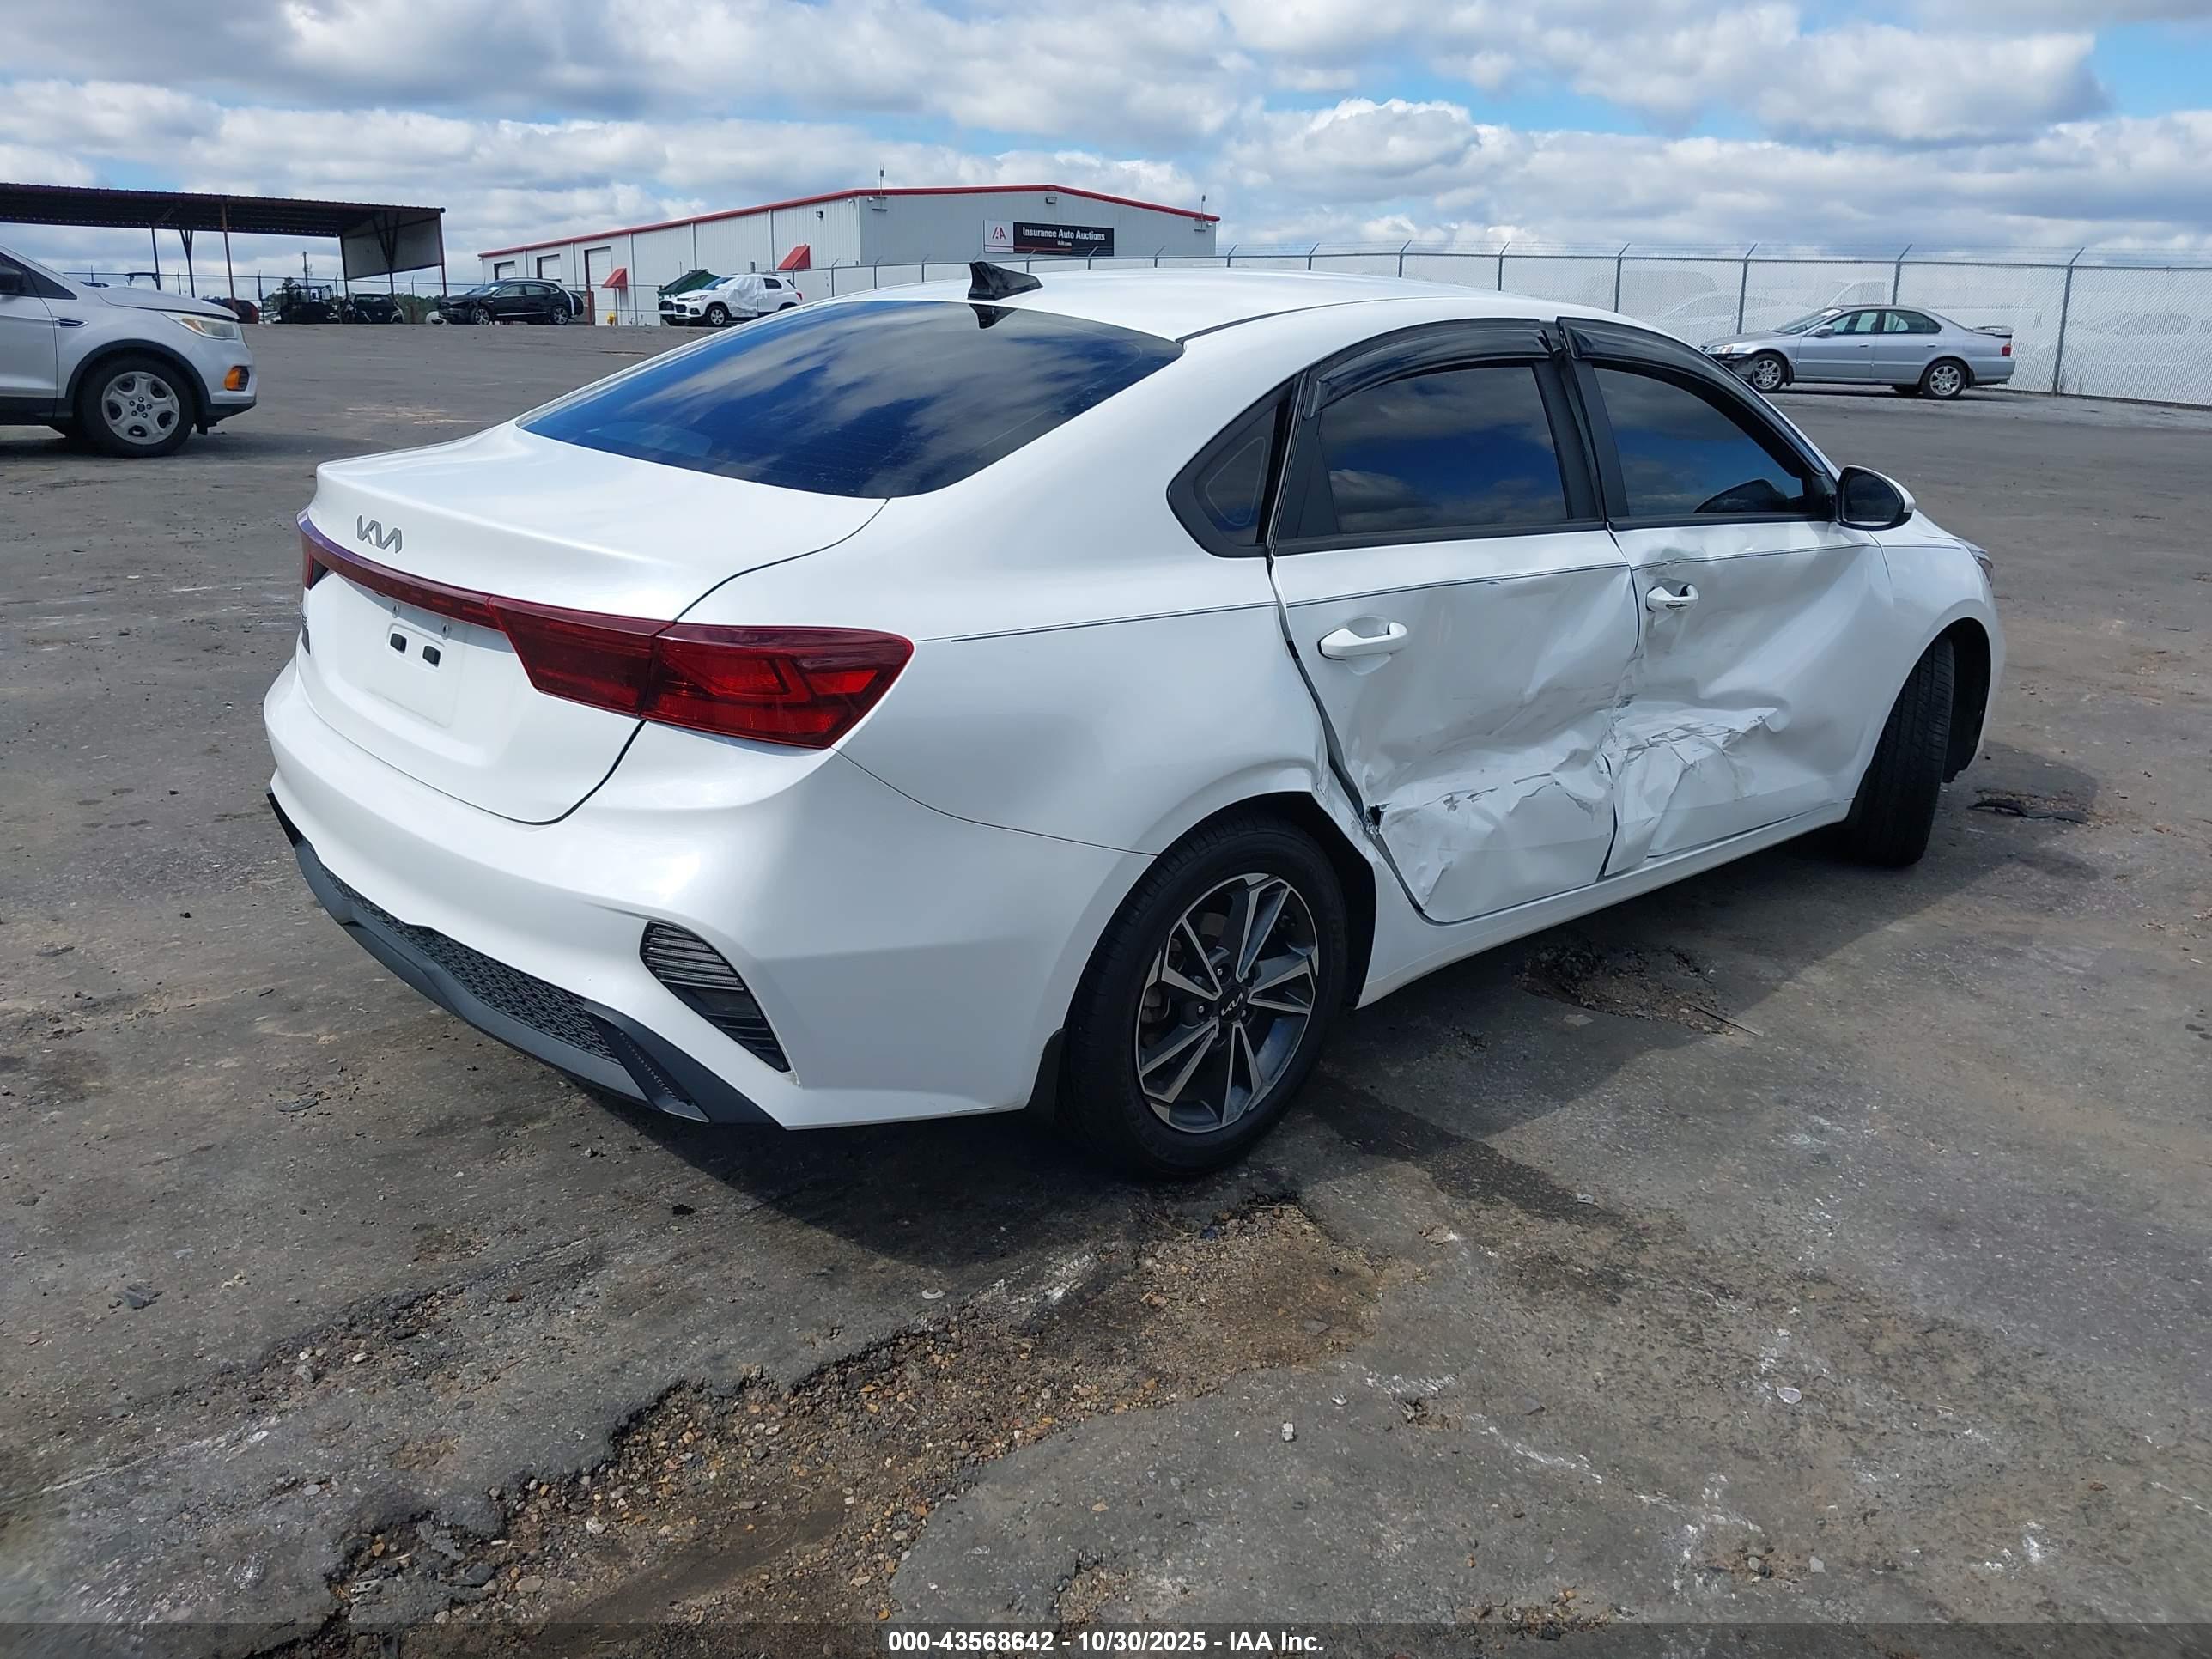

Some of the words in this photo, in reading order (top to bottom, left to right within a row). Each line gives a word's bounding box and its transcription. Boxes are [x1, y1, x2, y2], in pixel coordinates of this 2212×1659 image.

[1022, 226, 1057, 238] Insurance
[1058, 228, 1075, 240] Auto
[1075, 229, 1105, 241] Auctions
